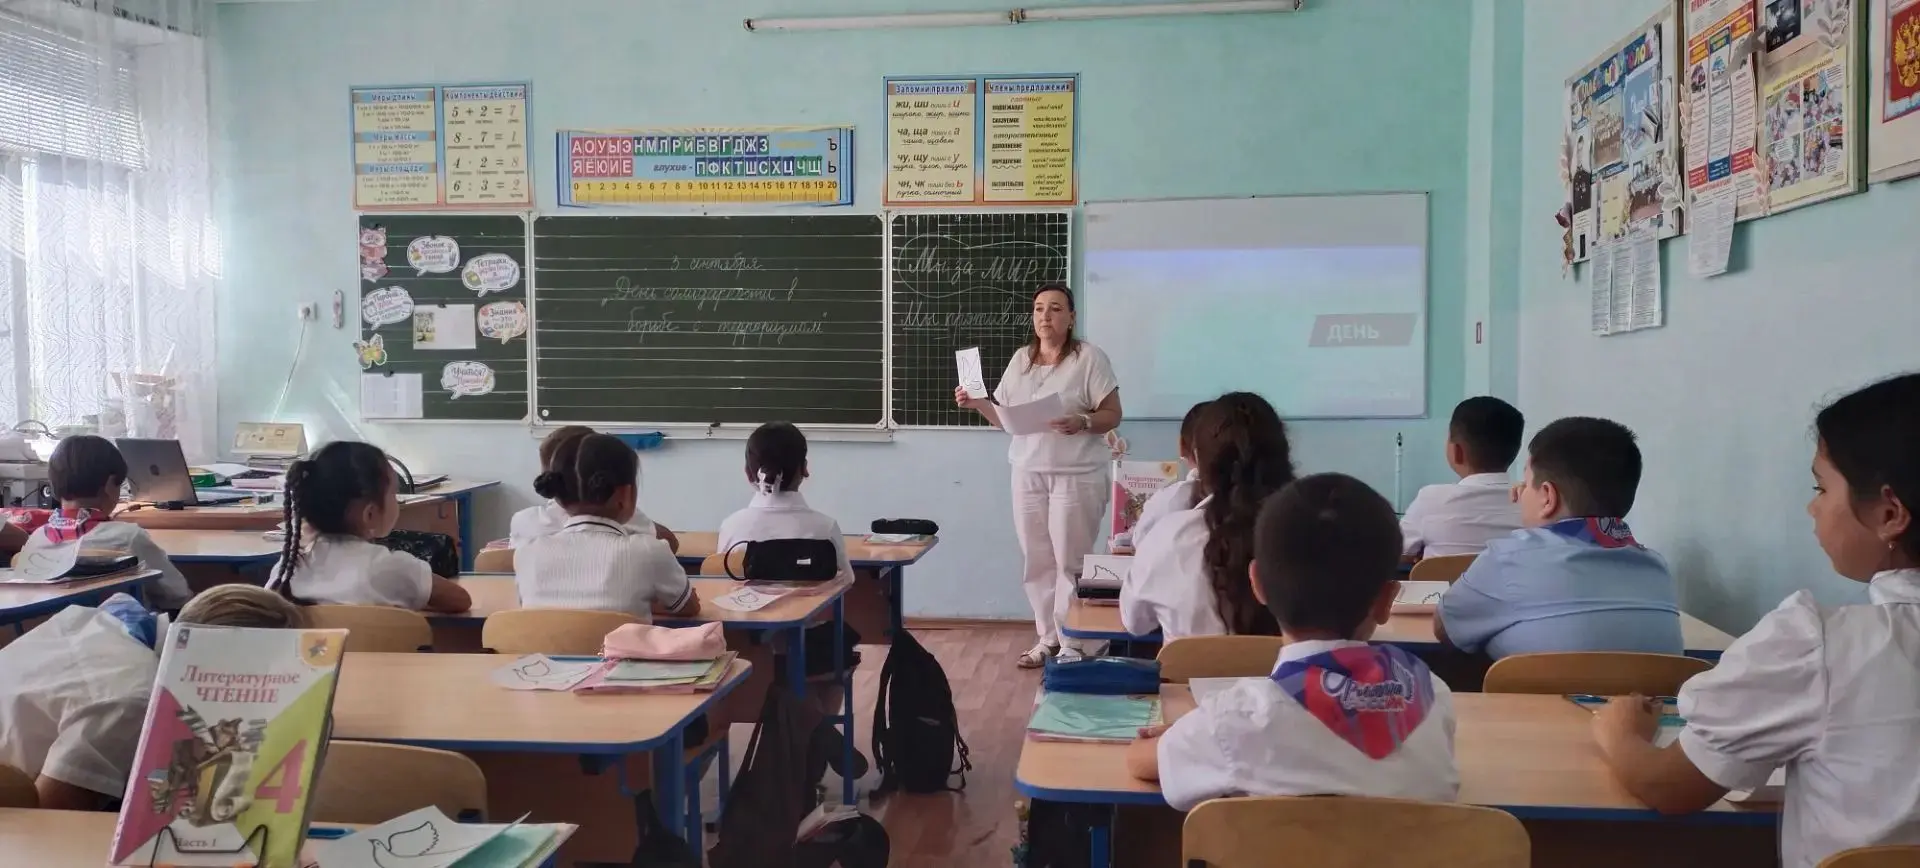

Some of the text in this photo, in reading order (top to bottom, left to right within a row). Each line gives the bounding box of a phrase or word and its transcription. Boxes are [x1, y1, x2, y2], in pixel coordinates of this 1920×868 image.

[896, 84, 930, 94] Запомни
[451, 106, 459, 117] 5
[480, 105, 488, 117] 2
[509, 104, 517, 116] 7
[895, 100, 911, 109] жи,
[914, 100, 929, 108] ши
[953, 99, 961, 108] и
[453, 132, 462, 144] 8
[480, 131, 489, 143] 7
[897, 127, 910, 137] ча,
[913, 127, 928, 137] ща
[452, 157, 460, 169] 4
[480, 156, 488, 168] 2
[511, 156, 519, 168] 8
[897, 154, 911, 164] чу,
[913, 154, 929, 164] щу
[453, 180, 461, 192] 6
[480, 179, 488, 191] 3
[512, 178, 521, 190] 2
[574, 181, 838, 190] 0 1 2 3 4 5 6 7 8 9 10 11 12 13 14 15 16 17 18 19 20
[1326, 323, 1380, 344] ДЕНЬ
[180, 664, 301, 688] Литературное
[196, 686, 281, 704] ЧТЕНИЕ
[254, 738, 308, 814] 4
